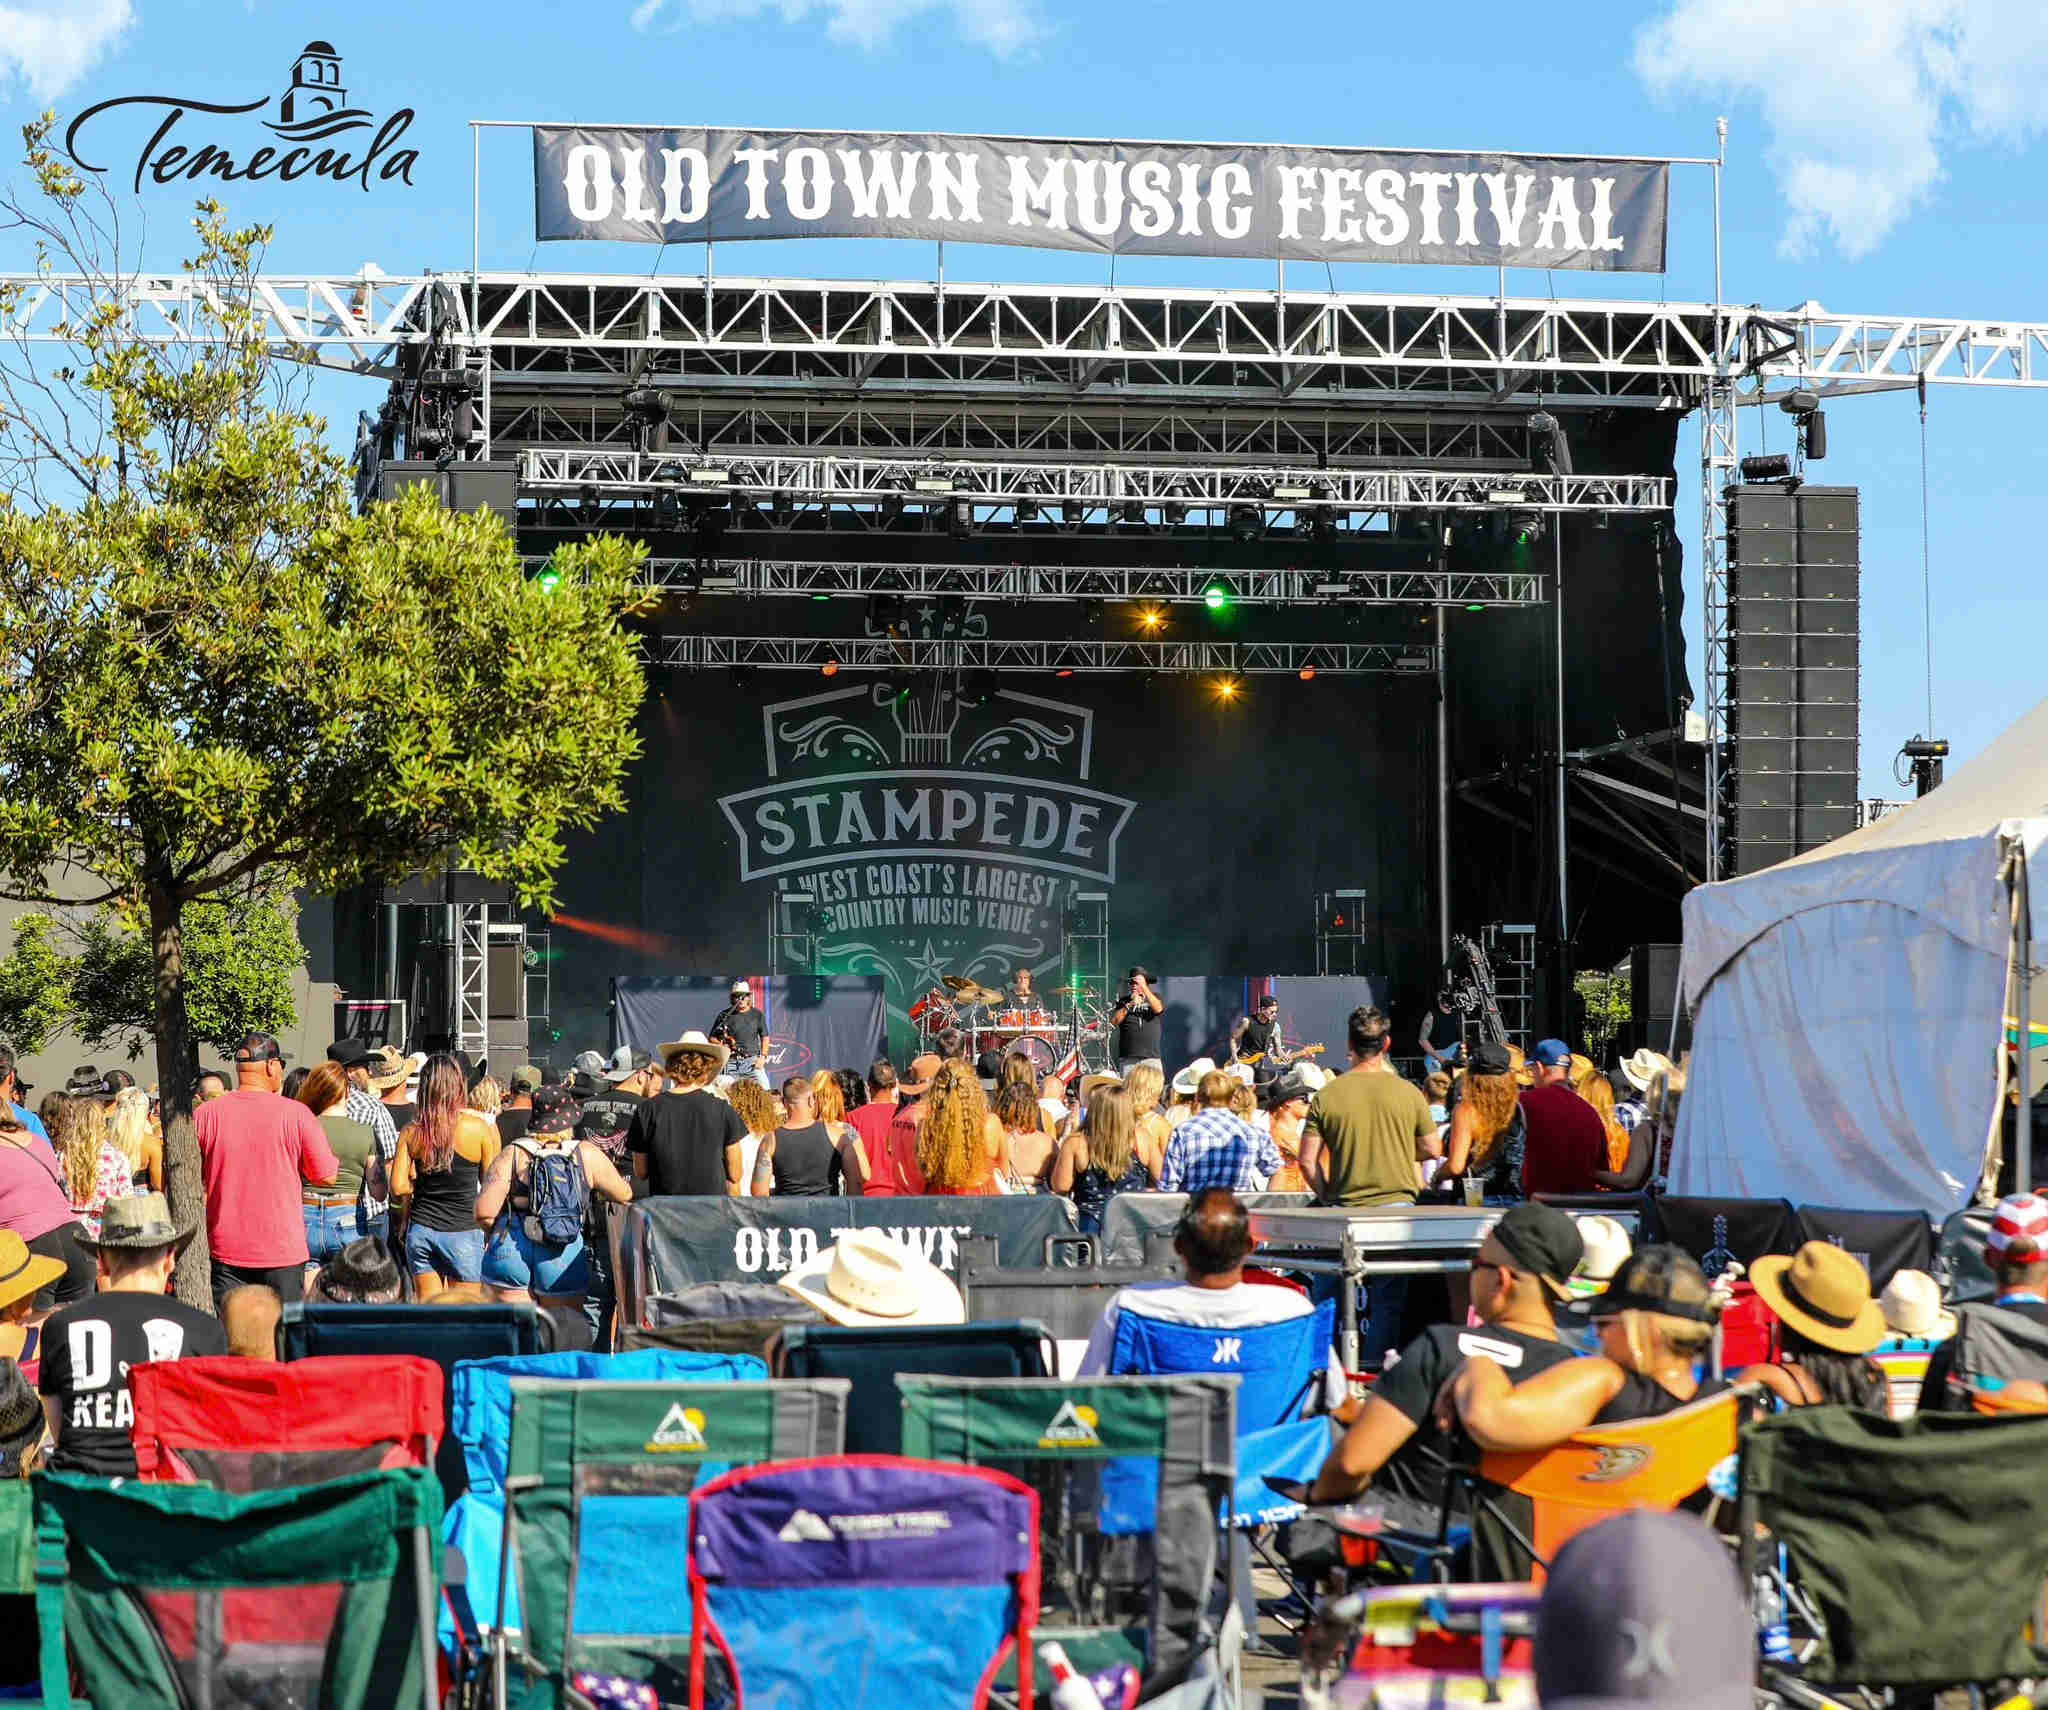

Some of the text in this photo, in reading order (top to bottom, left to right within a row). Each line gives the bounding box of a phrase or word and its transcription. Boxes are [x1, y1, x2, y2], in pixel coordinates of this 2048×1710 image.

[563, 144, 1624, 251] OLD TOWN MUSIC FESTIVAL
[755, 788, 1102, 859] STAMPEDE
[798, 863, 1061, 908] WEST COAST'S LARGEST
[823, 897, 1035, 935] COUNTRY MUSIC VENUE
[733, 1226, 972, 1273] OLD WN
